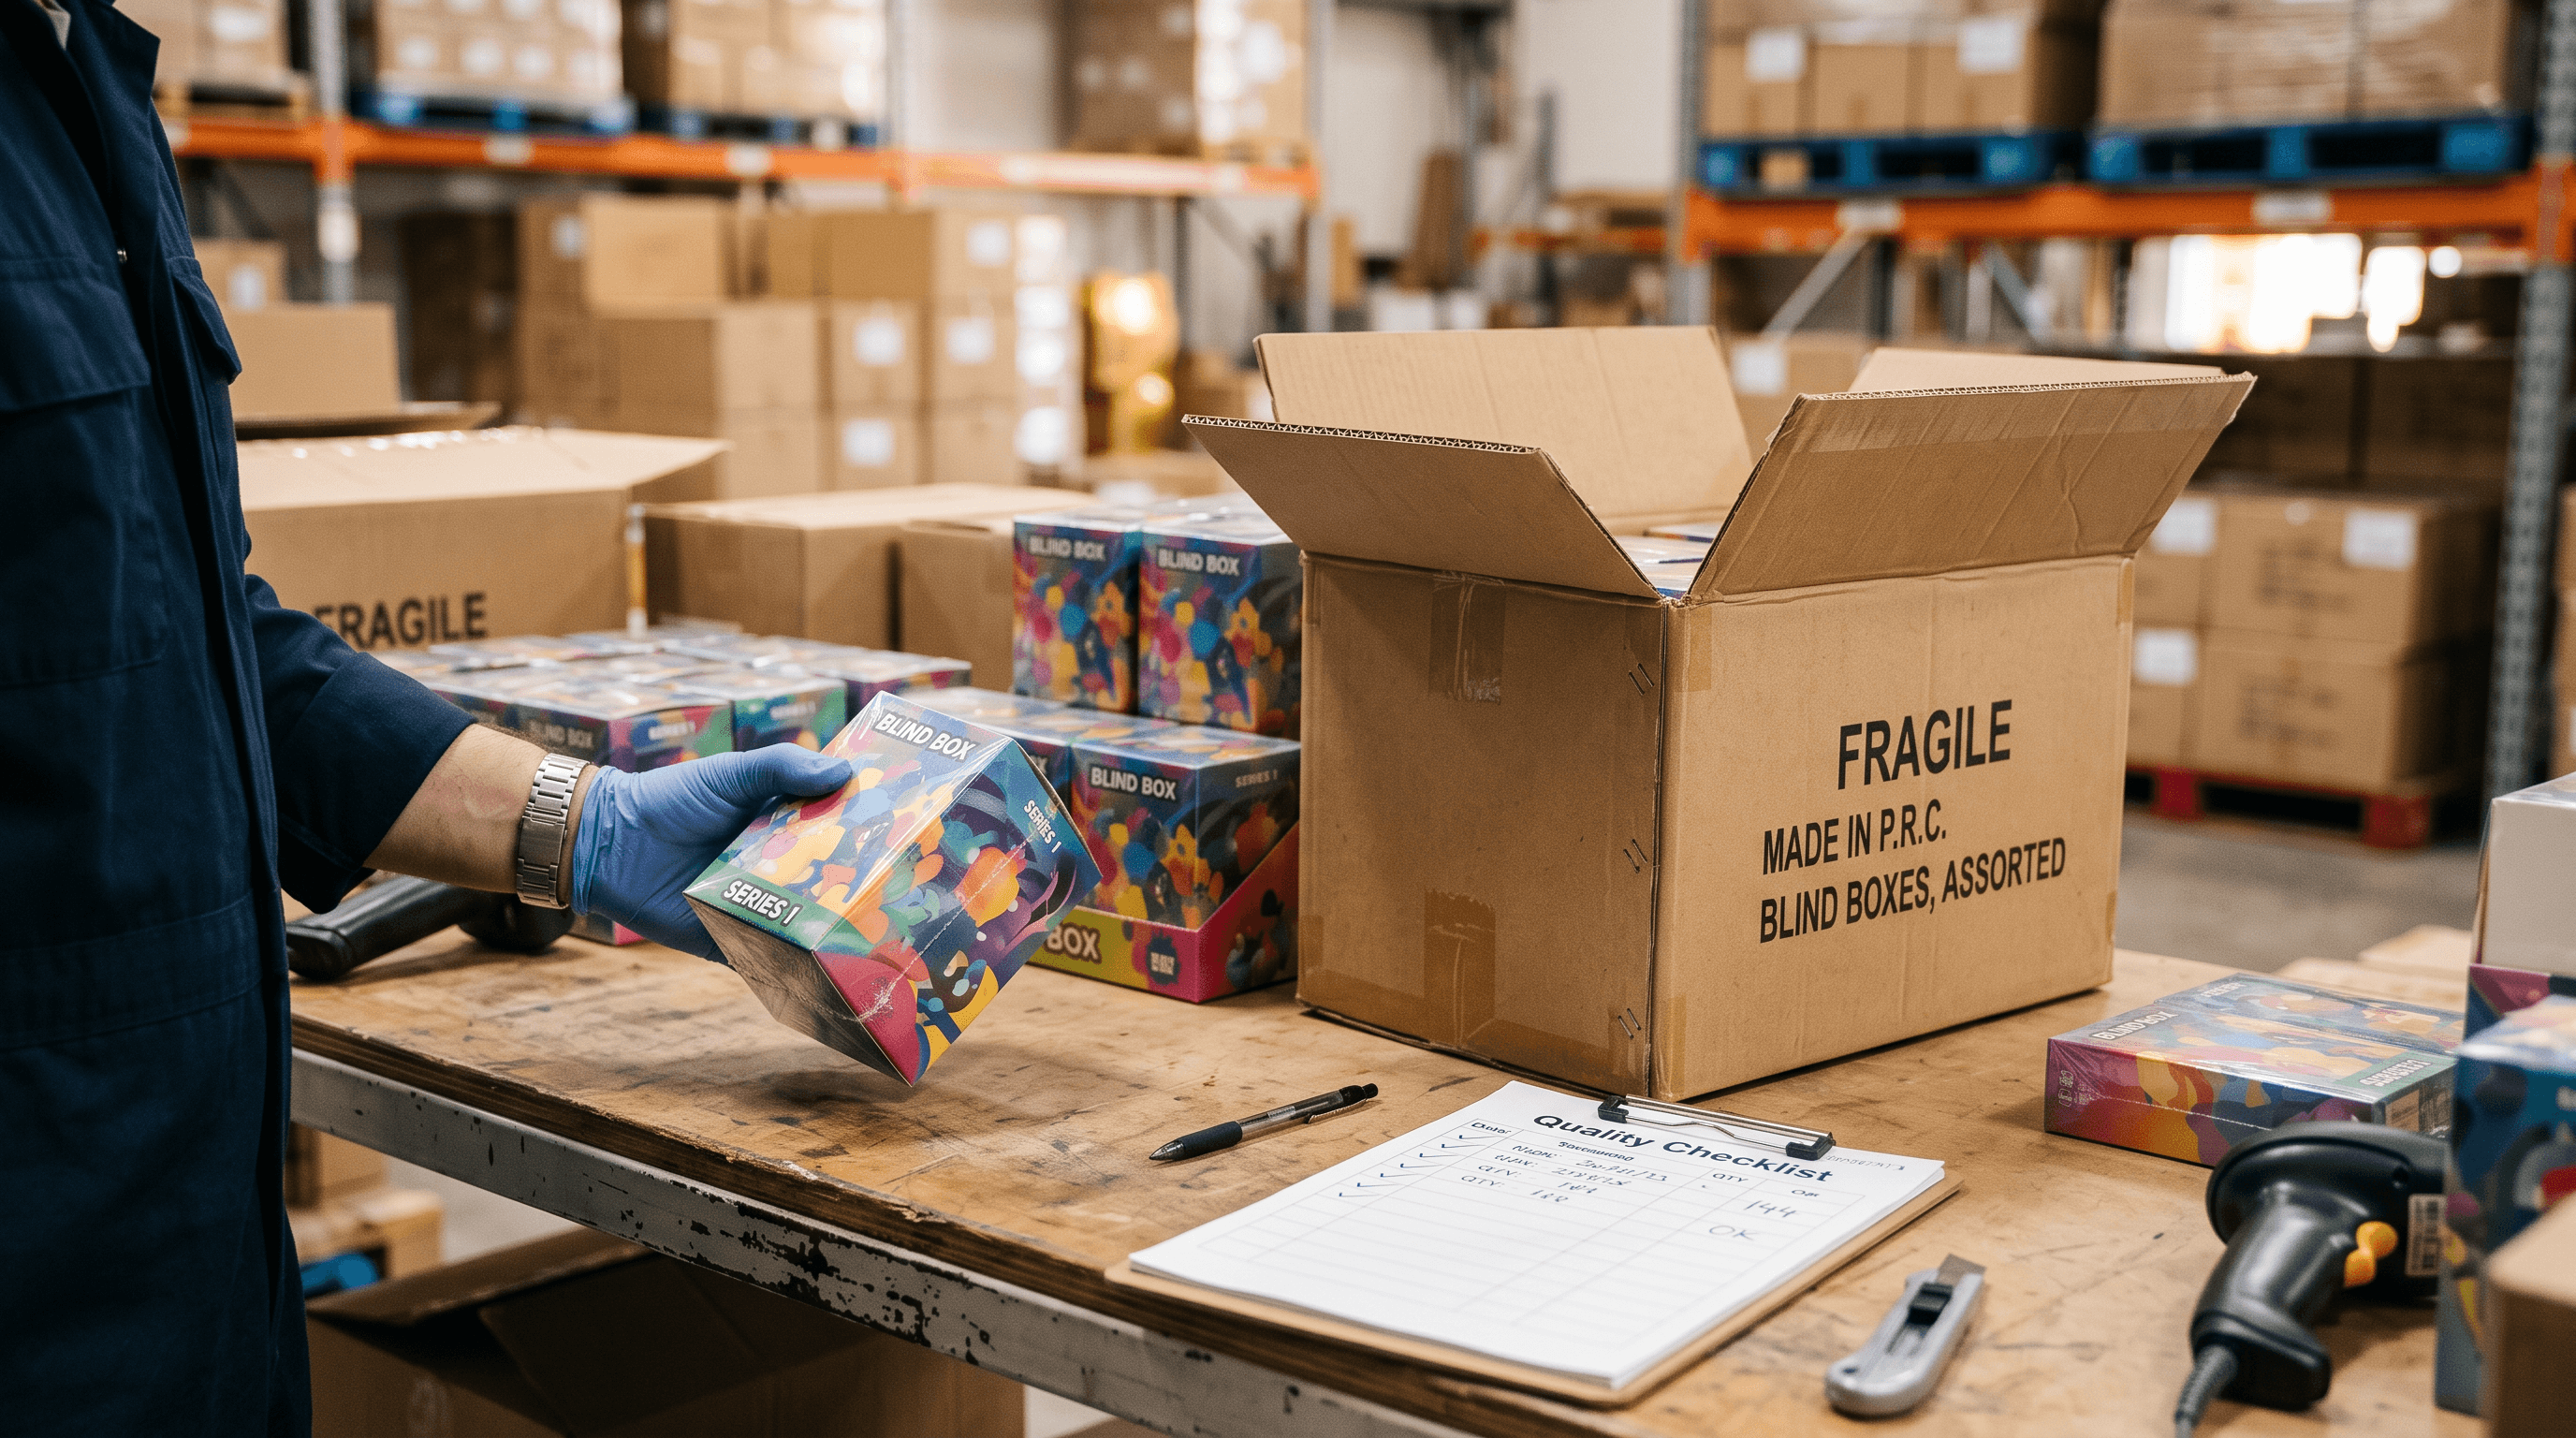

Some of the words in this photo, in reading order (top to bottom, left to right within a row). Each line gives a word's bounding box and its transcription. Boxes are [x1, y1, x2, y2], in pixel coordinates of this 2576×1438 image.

[1158, 548, 1203, 572] BLIND
[1207, 554, 1239, 576] BOX
[875, 712, 934, 744] BLIND
[929, 733, 976, 760] BOX
[1837, 699, 2012, 790] FRAGILE
[1090, 767, 1138, 793] BLIND
[1141, 776, 1177, 800] BOX
[1235, 771, 1270, 788] SERIES
[1023, 800, 1056, 844] SERIES
[1763, 818, 1839, 875] MADE
[1847, 812, 1871, 858] IN
[1880, 799, 1947, 852] P.R.C.
[724, 880, 788, 918] SERIES
[1760, 886, 1837, 944] BLIND
[1846, 865, 1936, 925] BOXES,
[1941, 837, 2066, 902] ASSORTED
[1533, 1115, 1655, 1147] Quality
[1662, 1141, 1834, 1181] Checklist
[1712, 1173, 1749, 1182] QTY
[1744, 1199, 1797, 1218] 144
[1709, 1225, 1758, 1241] OK
